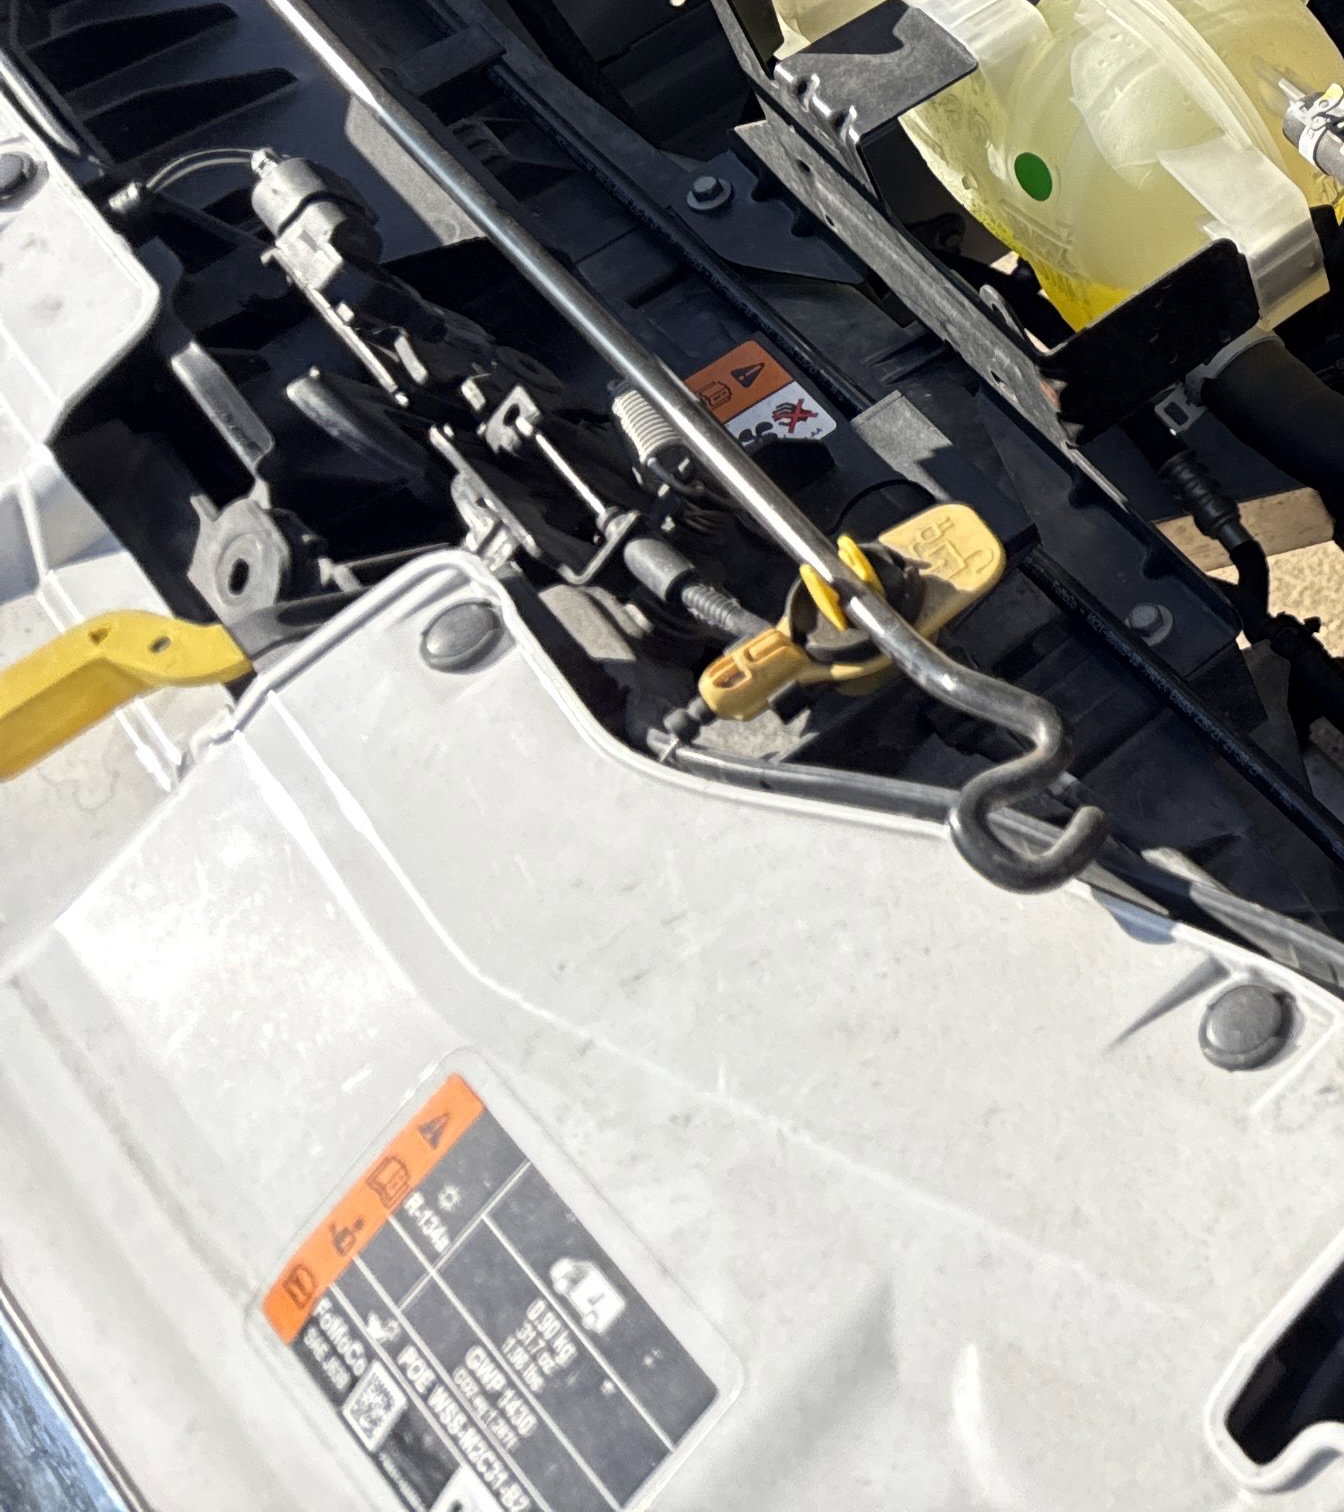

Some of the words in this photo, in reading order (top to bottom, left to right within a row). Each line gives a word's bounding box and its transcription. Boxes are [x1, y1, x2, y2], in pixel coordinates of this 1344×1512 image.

[405, 1194, 451, 1254] R-134a
[311, 1300, 367, 1377] FoMoCo
[526, 1299, 561, 1342] 0.90
[552, 1330, 578, 1367] kg
[395, 1345, 436, 1394] POE
[466, 1345, 506, 1393] GWP
[497, 1388, 538, 1437] 1430
